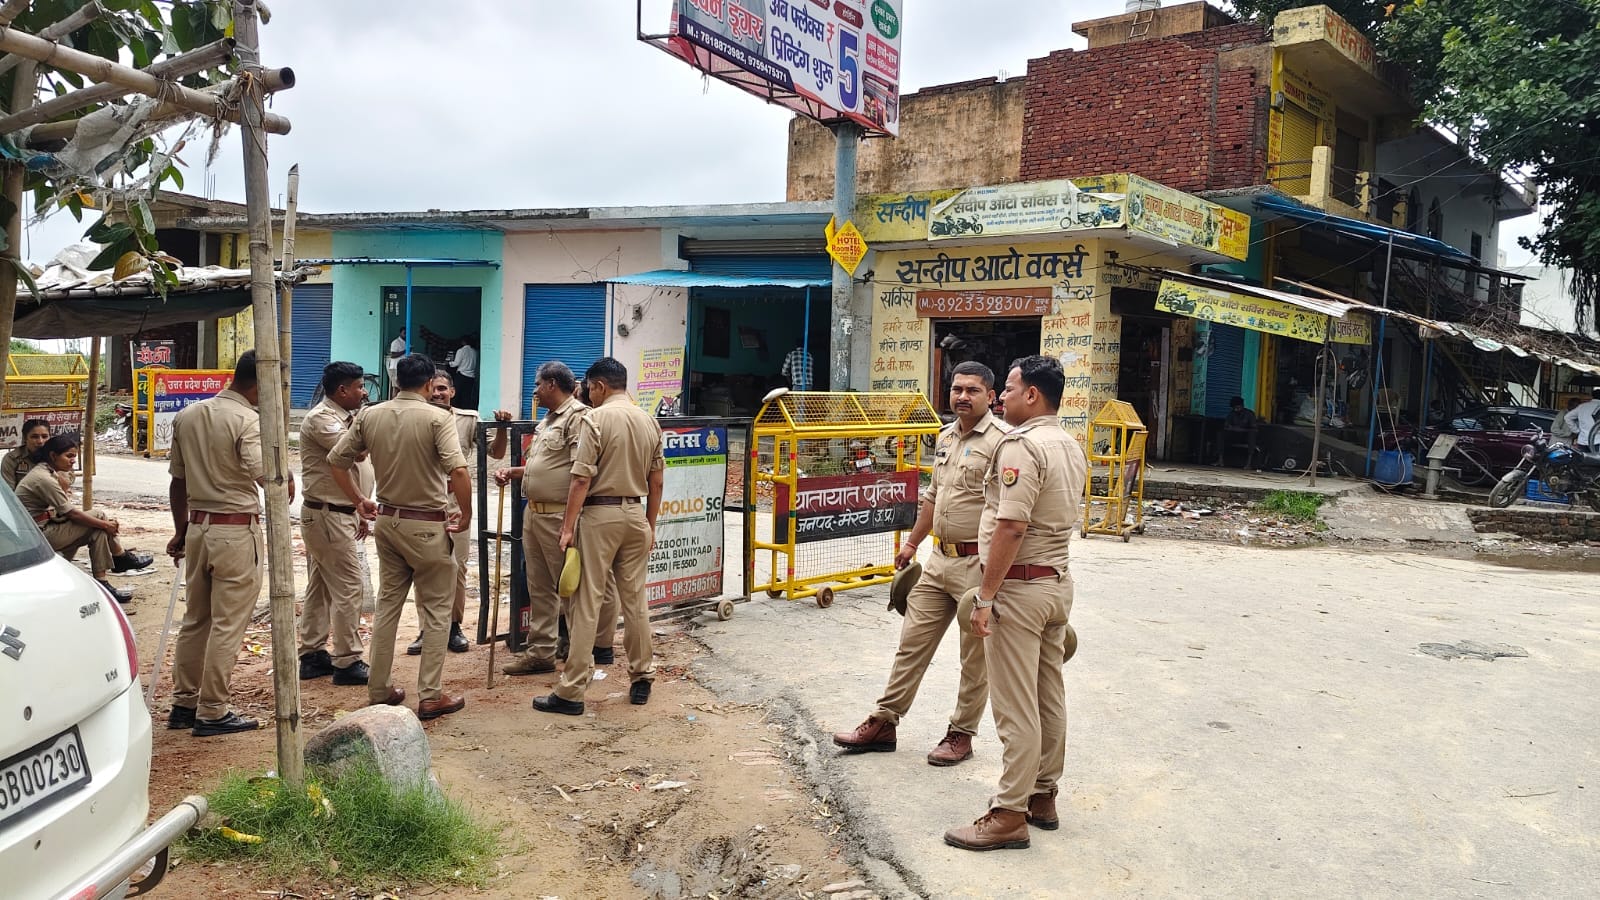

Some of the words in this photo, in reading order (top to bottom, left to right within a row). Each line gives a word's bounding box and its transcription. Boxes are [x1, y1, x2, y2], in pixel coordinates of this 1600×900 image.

[838, 25, 859, 110] 5
[896, 252, 969, 287] सन्दीप
[880, 286, 915, 309] सर्विस
[167, 380, 182, 390] उत्तर
[184, 377, 201, 391] प्रदेश
[202, 377, 221, 392] पुलिस
[662, 430, 701, 449] लिस
[795, 485, 860, 512] यातायात
[862, 480, 906, 507] पुलिस
[653, 537, 689, 550] AZBOOTI
[691, 535, 700, 545] KI
[647, 551, 671, 563] ISAAL
[672, 545, 712, 559] BUNIYAAD
[646, 585, 666, 602] HERA
